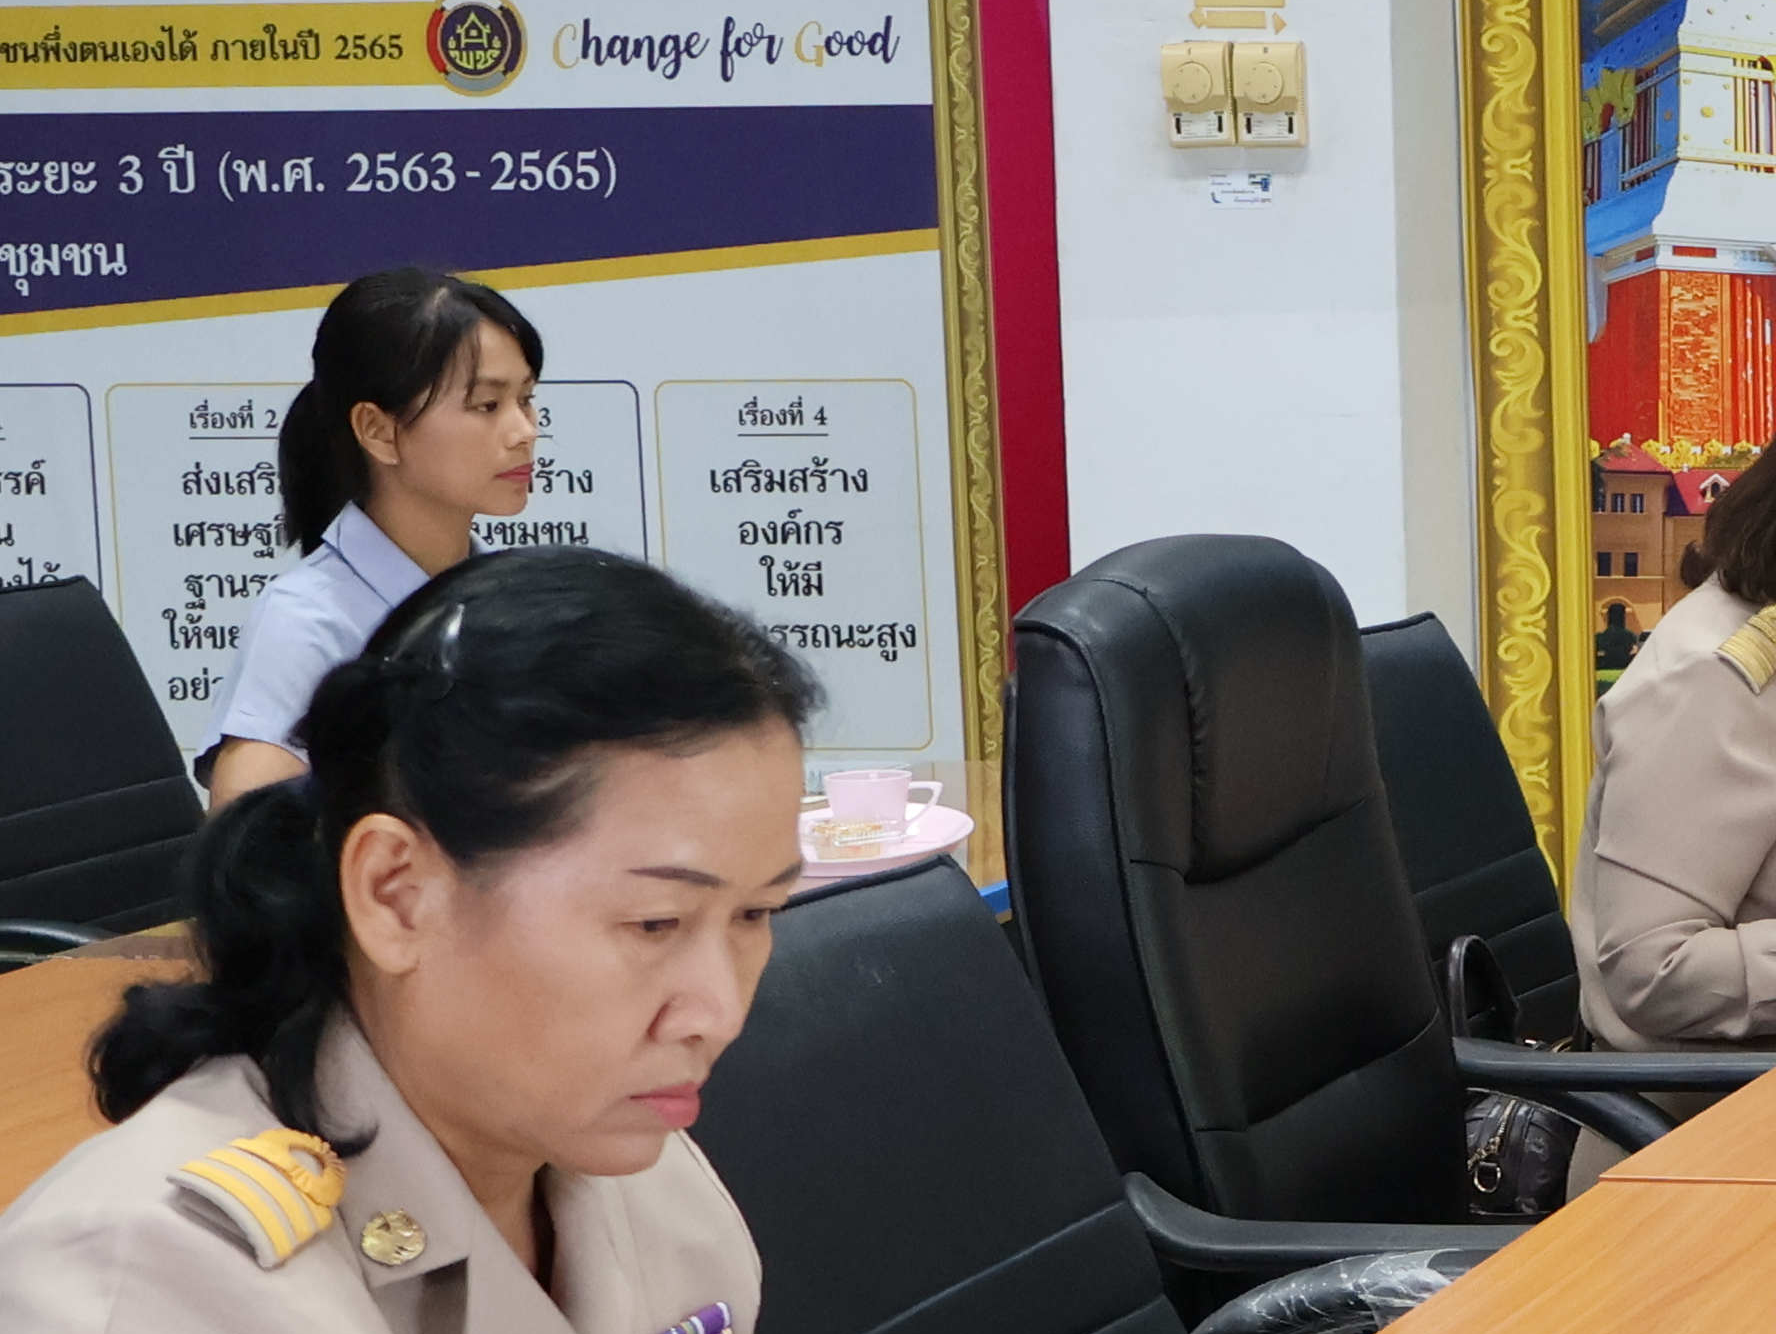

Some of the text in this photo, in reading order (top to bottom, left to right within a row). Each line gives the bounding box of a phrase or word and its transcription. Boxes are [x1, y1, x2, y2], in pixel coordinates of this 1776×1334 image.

[0, 23, 404, 65] ชนพึ่งตนเองได้ ภายในปี 2565
[552, 14, 901, 83] Change for Good
[119, 154, 144, 195] 3
[158, 143, 196, 194] ปี
[218, 149, 325, 203] (พ.ศ.
[0, 240, 128, 298] ชุมชน
[189, 400, 278, 429] เรื่องที่ 2
[737, 396, 828, 427] เรื่องที่ 4
[182, 462, 282, 496] ส่งเสริ
[527, 458, 594, 494] ร้าง
[709, 456, 869, 494] เสริมสร้าง
[738, 509, 844, 546] องค์กร
[183, 572, 278, 610] ฐานร
[759, 555, 824, 597] ให้มี
